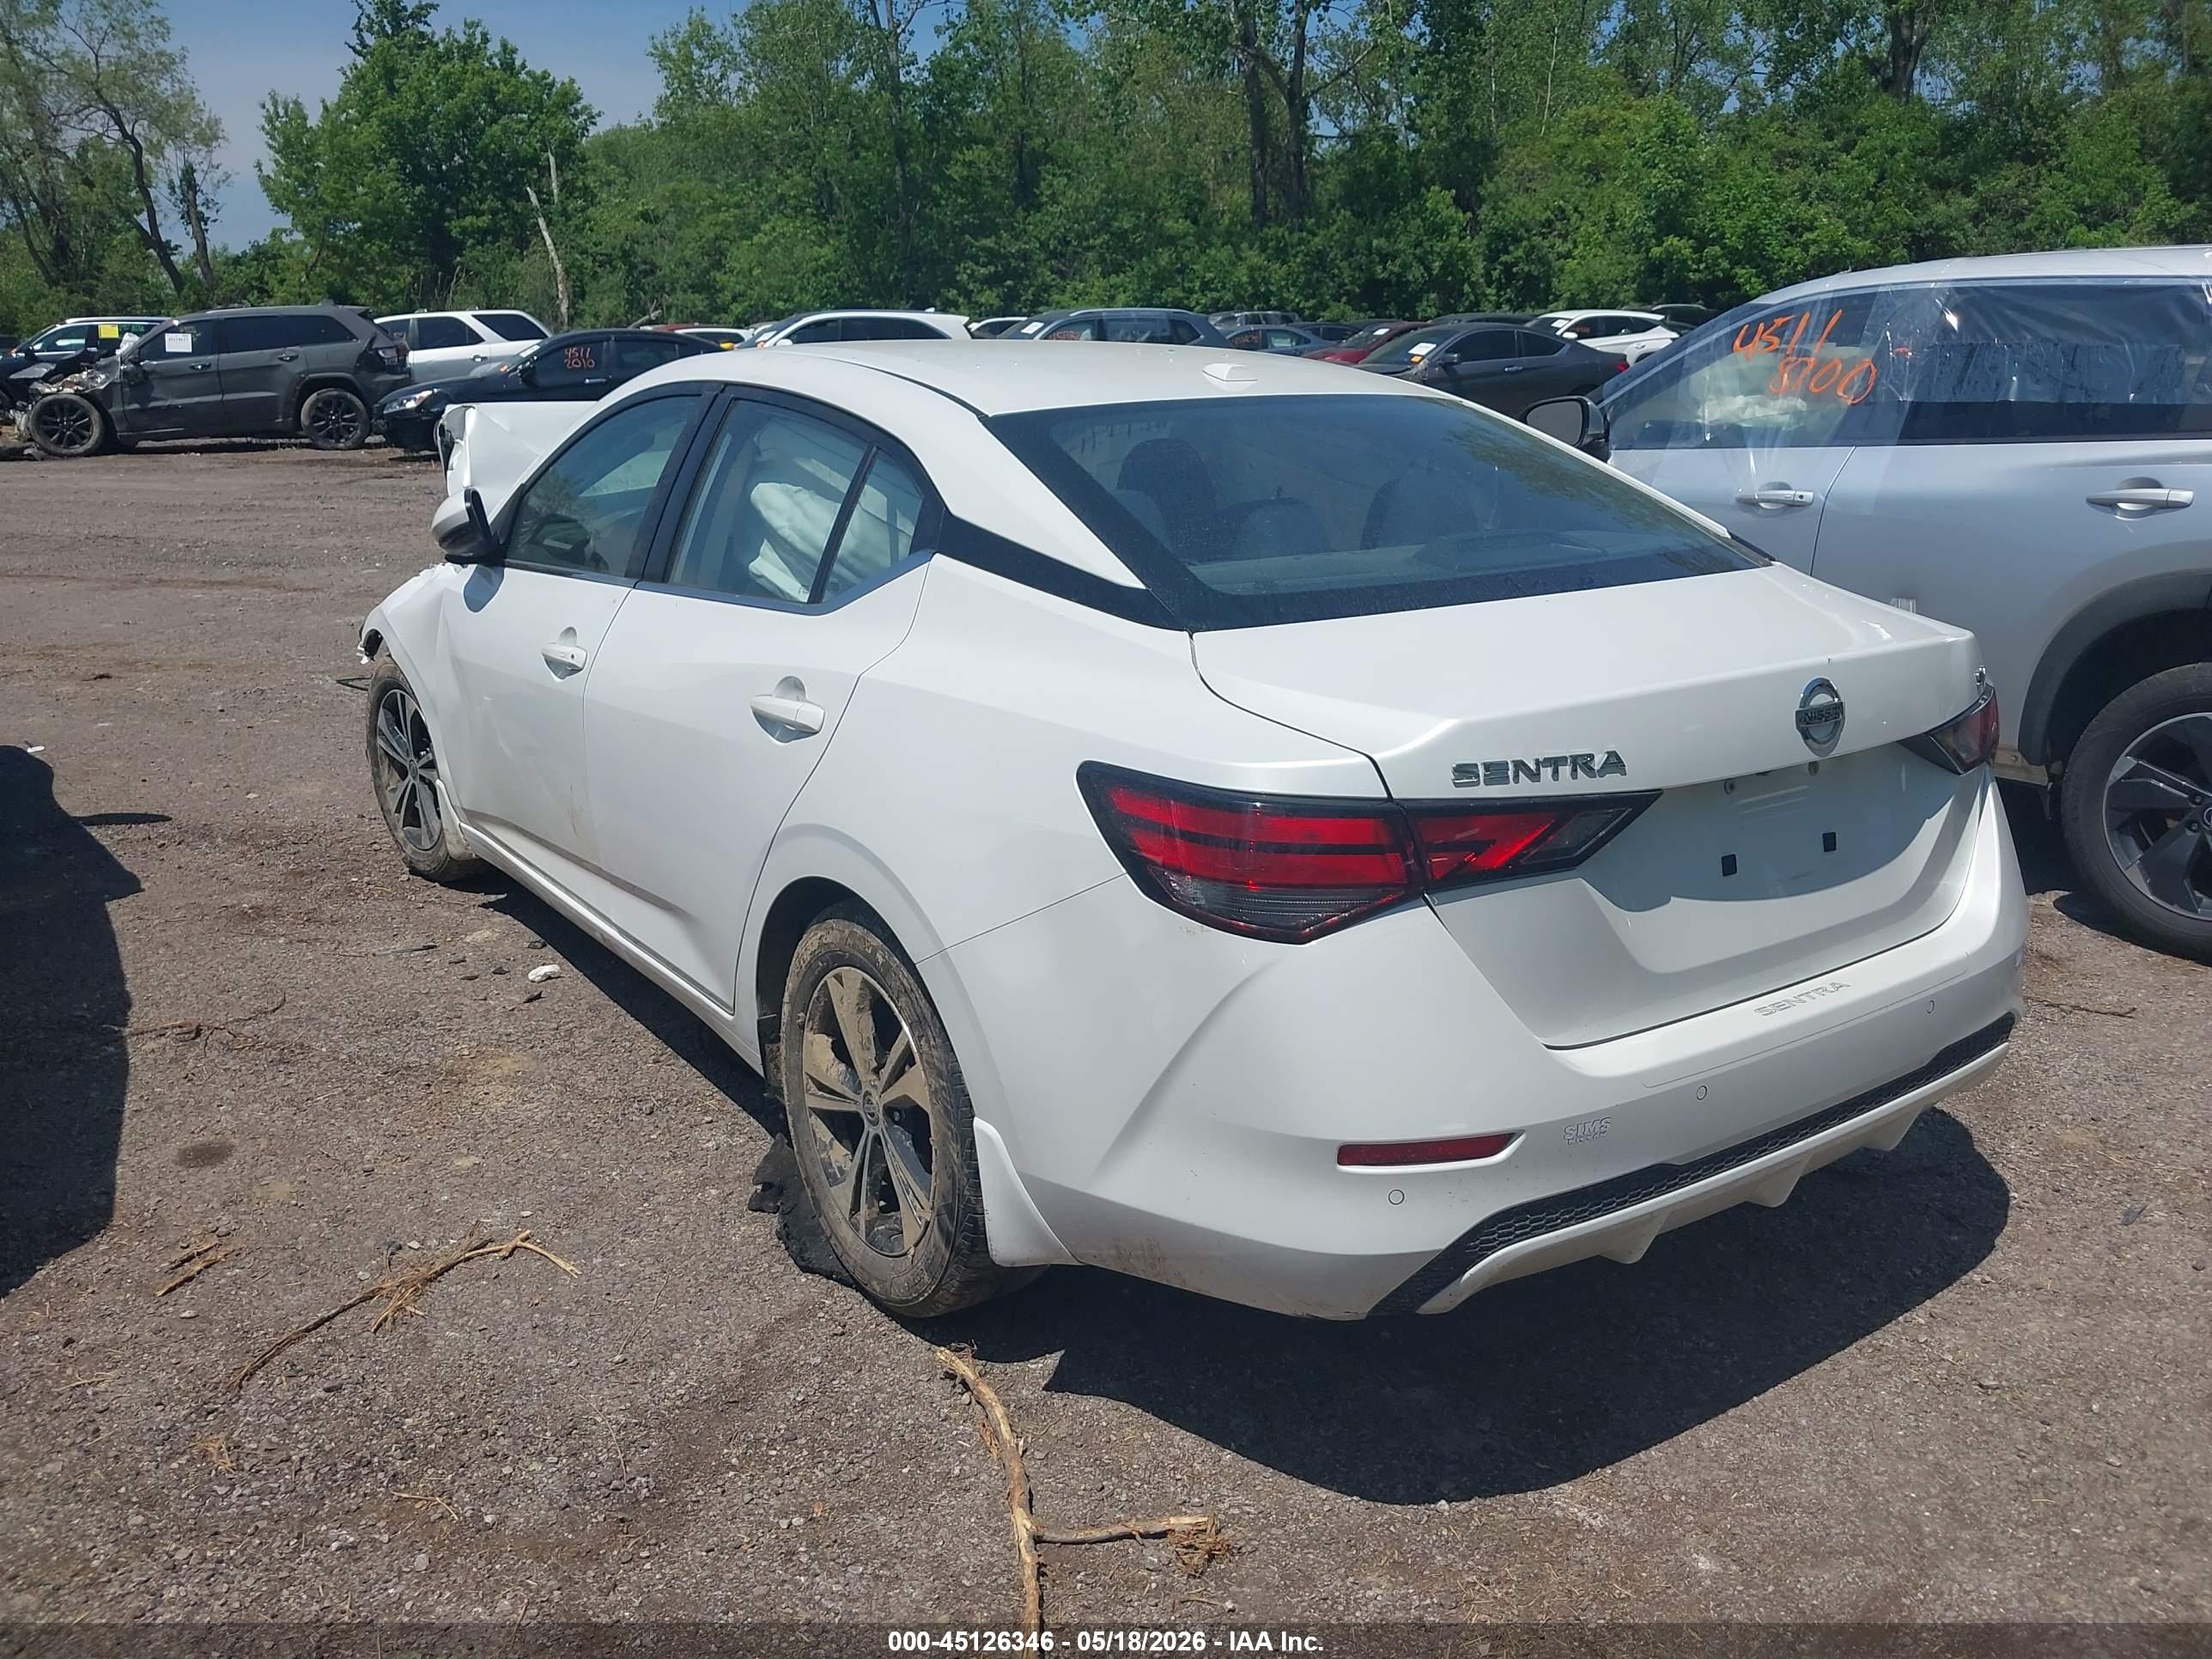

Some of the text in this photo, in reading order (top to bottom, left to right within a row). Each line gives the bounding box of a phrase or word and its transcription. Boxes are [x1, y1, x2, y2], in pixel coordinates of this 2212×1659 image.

[564, 347, 591, 359] 4511
[1732, 308, 1844, 363] 4511
[1451, 749, 1628, 789] SENTRA
[1753, 981, 1851, 1016] SENTRA
[1563, 1116, 1612, 1140] SIMS
